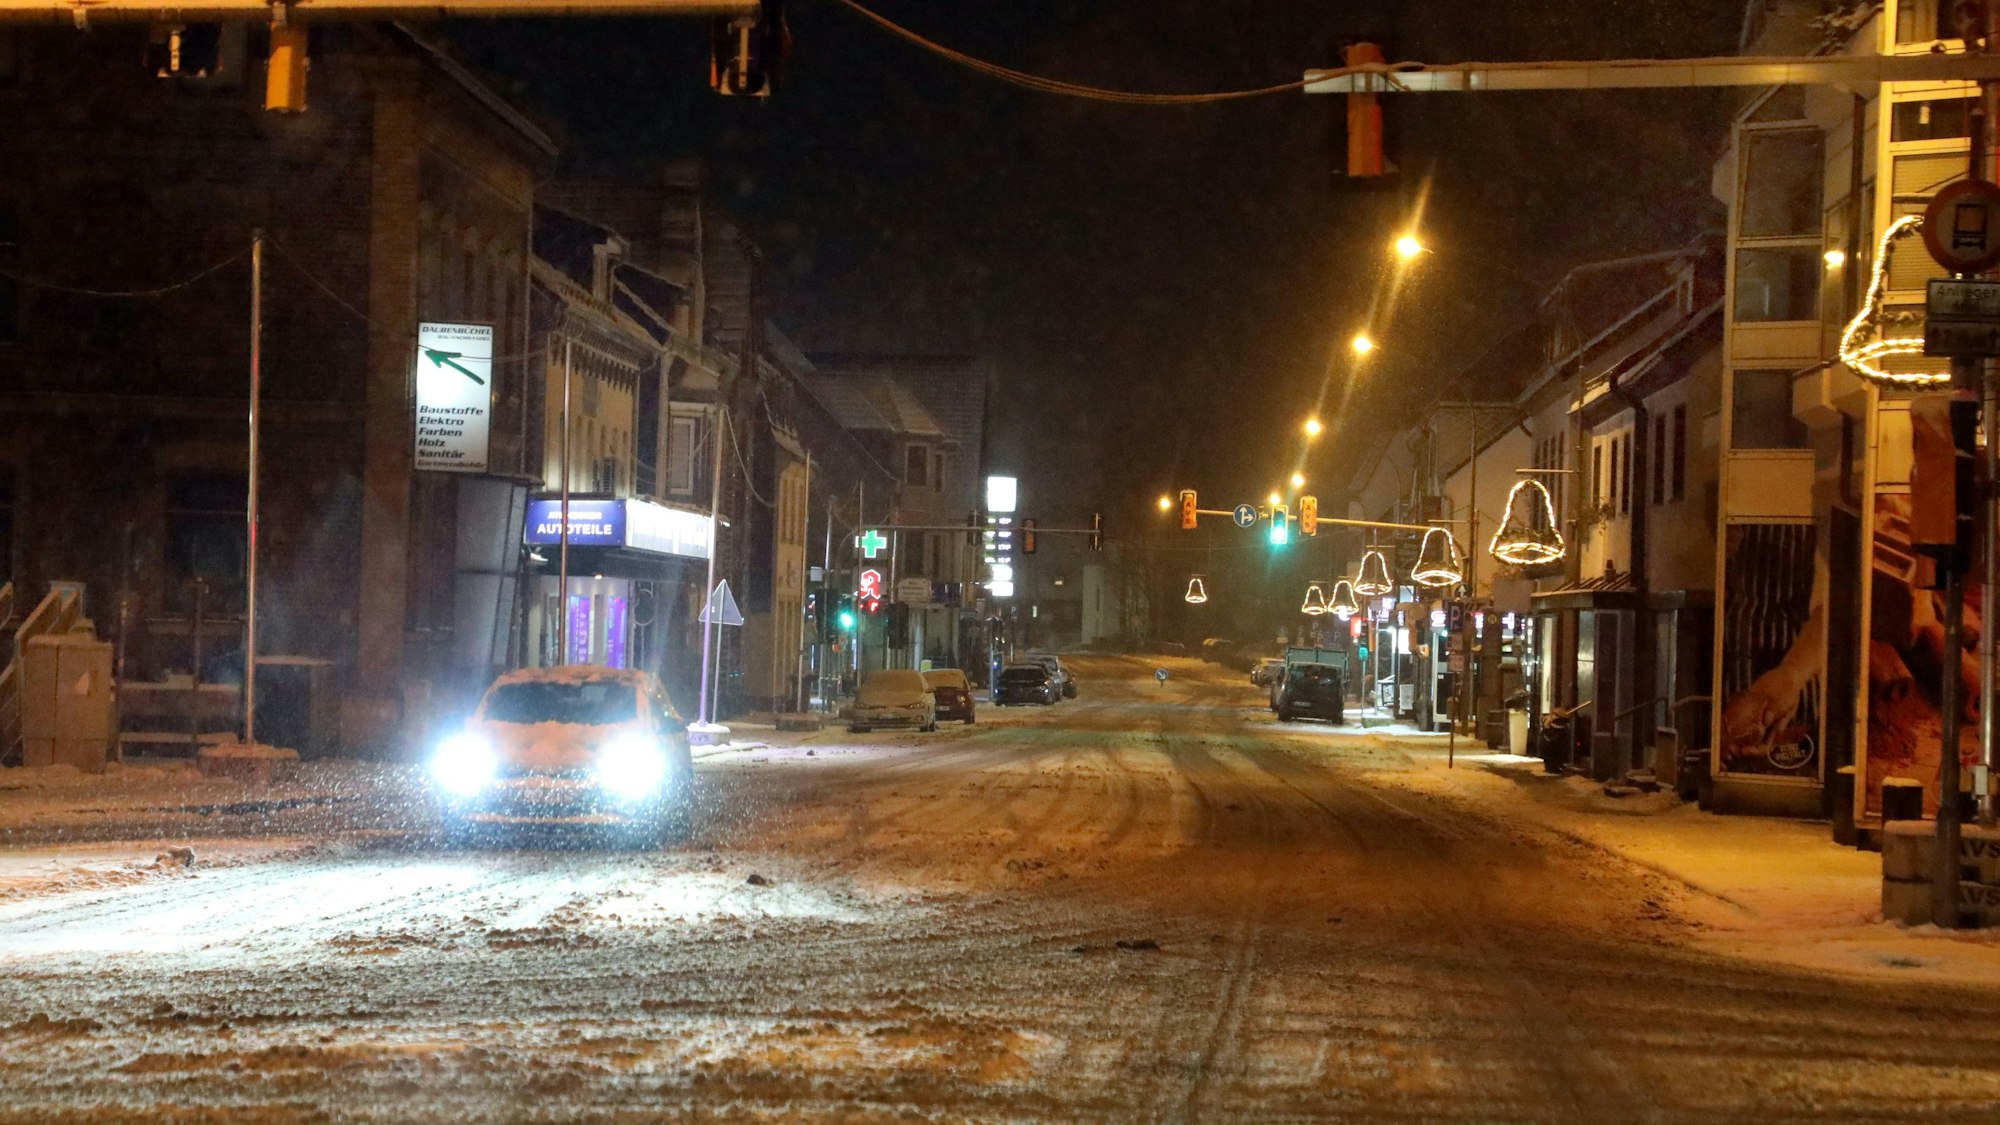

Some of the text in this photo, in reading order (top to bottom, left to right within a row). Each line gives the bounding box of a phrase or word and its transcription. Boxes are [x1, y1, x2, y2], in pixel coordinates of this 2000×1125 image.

[420, 405, 484, 415] Baustoffe
[419, 416, 464, 425] Elektro
[418, 427, 463, 437] Farben
[418, 438, 446, 447] Holz
[418, 449, 465, 458] Sanitär
[537, 523, 612, 535] AUTOTEILE
